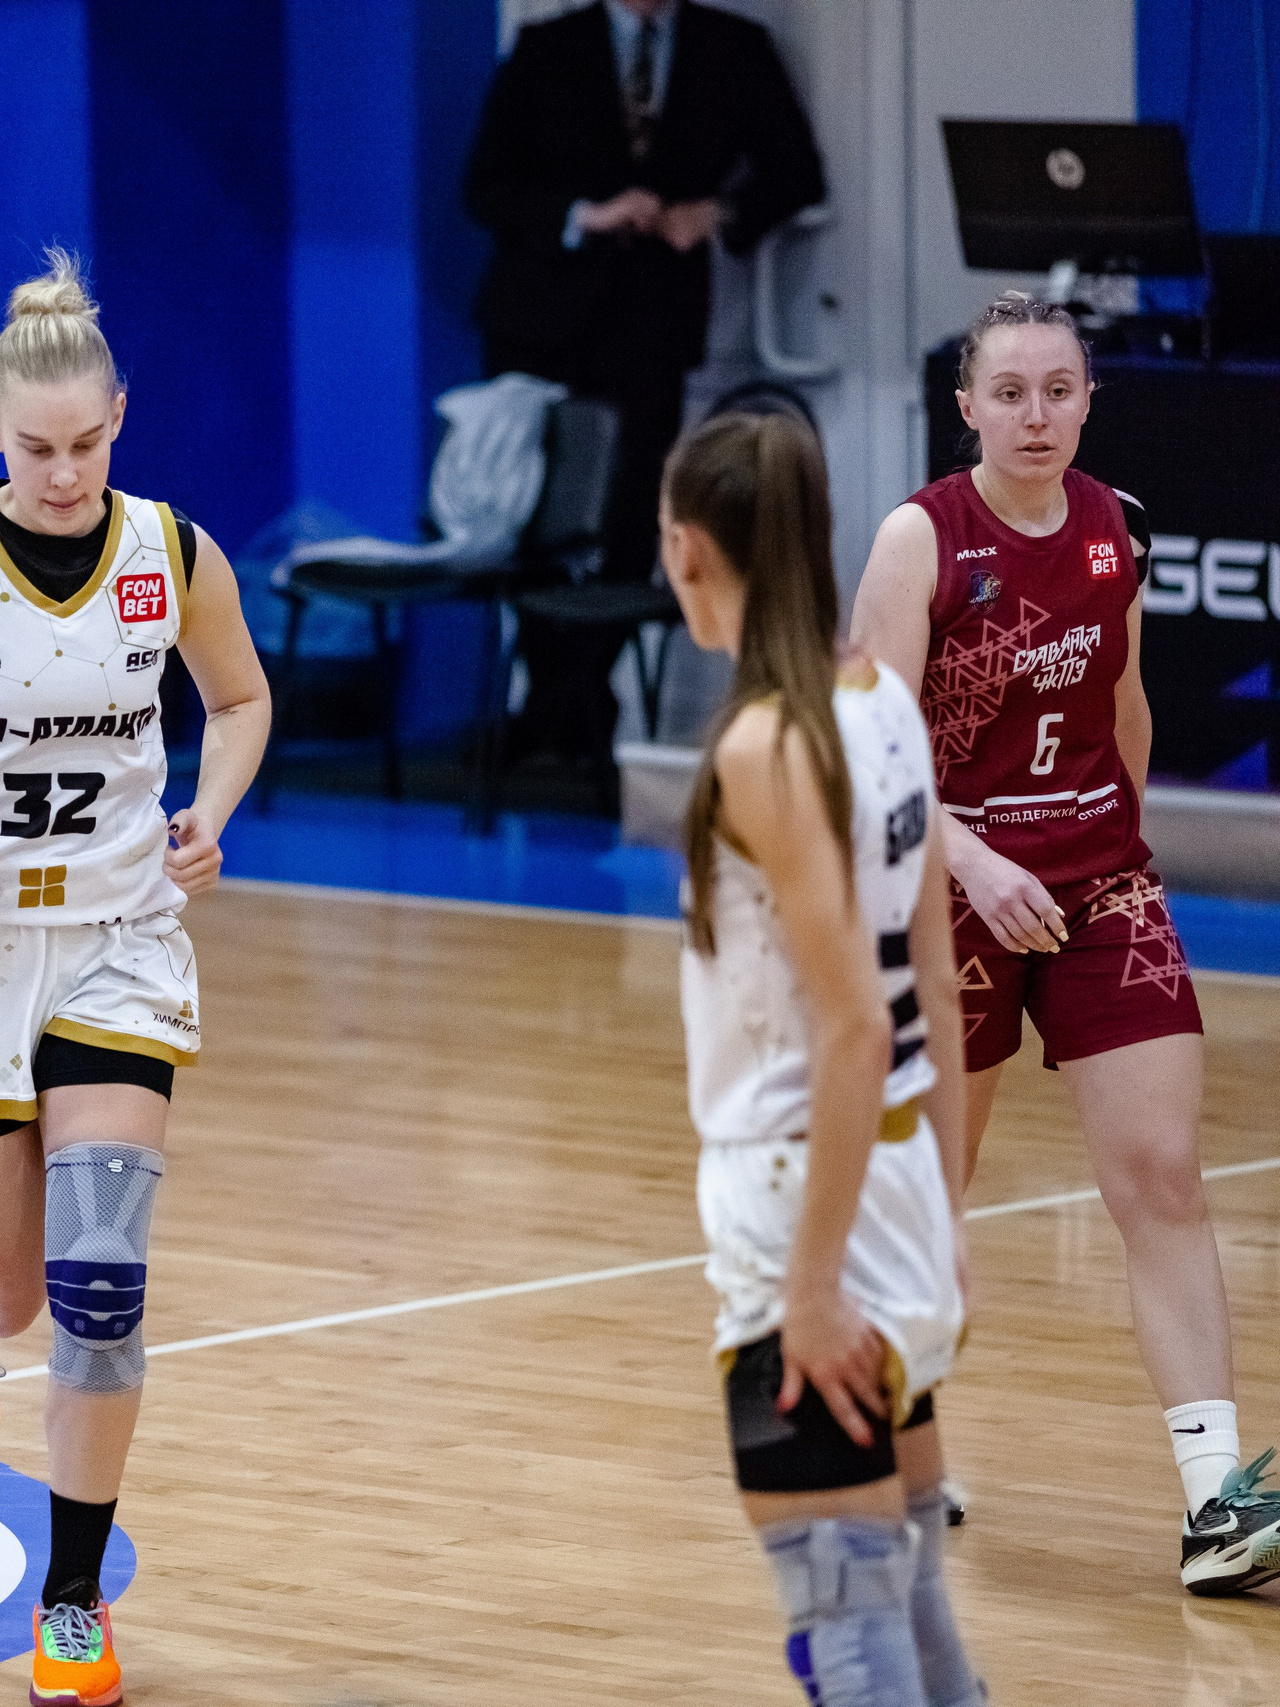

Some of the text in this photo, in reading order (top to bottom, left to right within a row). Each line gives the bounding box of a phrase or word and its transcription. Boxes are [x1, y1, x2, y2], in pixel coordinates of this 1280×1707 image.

[956, 546, 998, 561] MAXX
[1089, 543, 1115, 560] FON
[1092, 556, 1118, 575] BET
[1142, 532, 1280, 622] GE
[121, 578, 161, 598] FON
[123, 596, 163, 617] BET
[1029, 713, 1064, 775] 6
[0, 772, 106, 839] 32
[989, 806, 1077, 824] ПОДДЕРЖКИ
